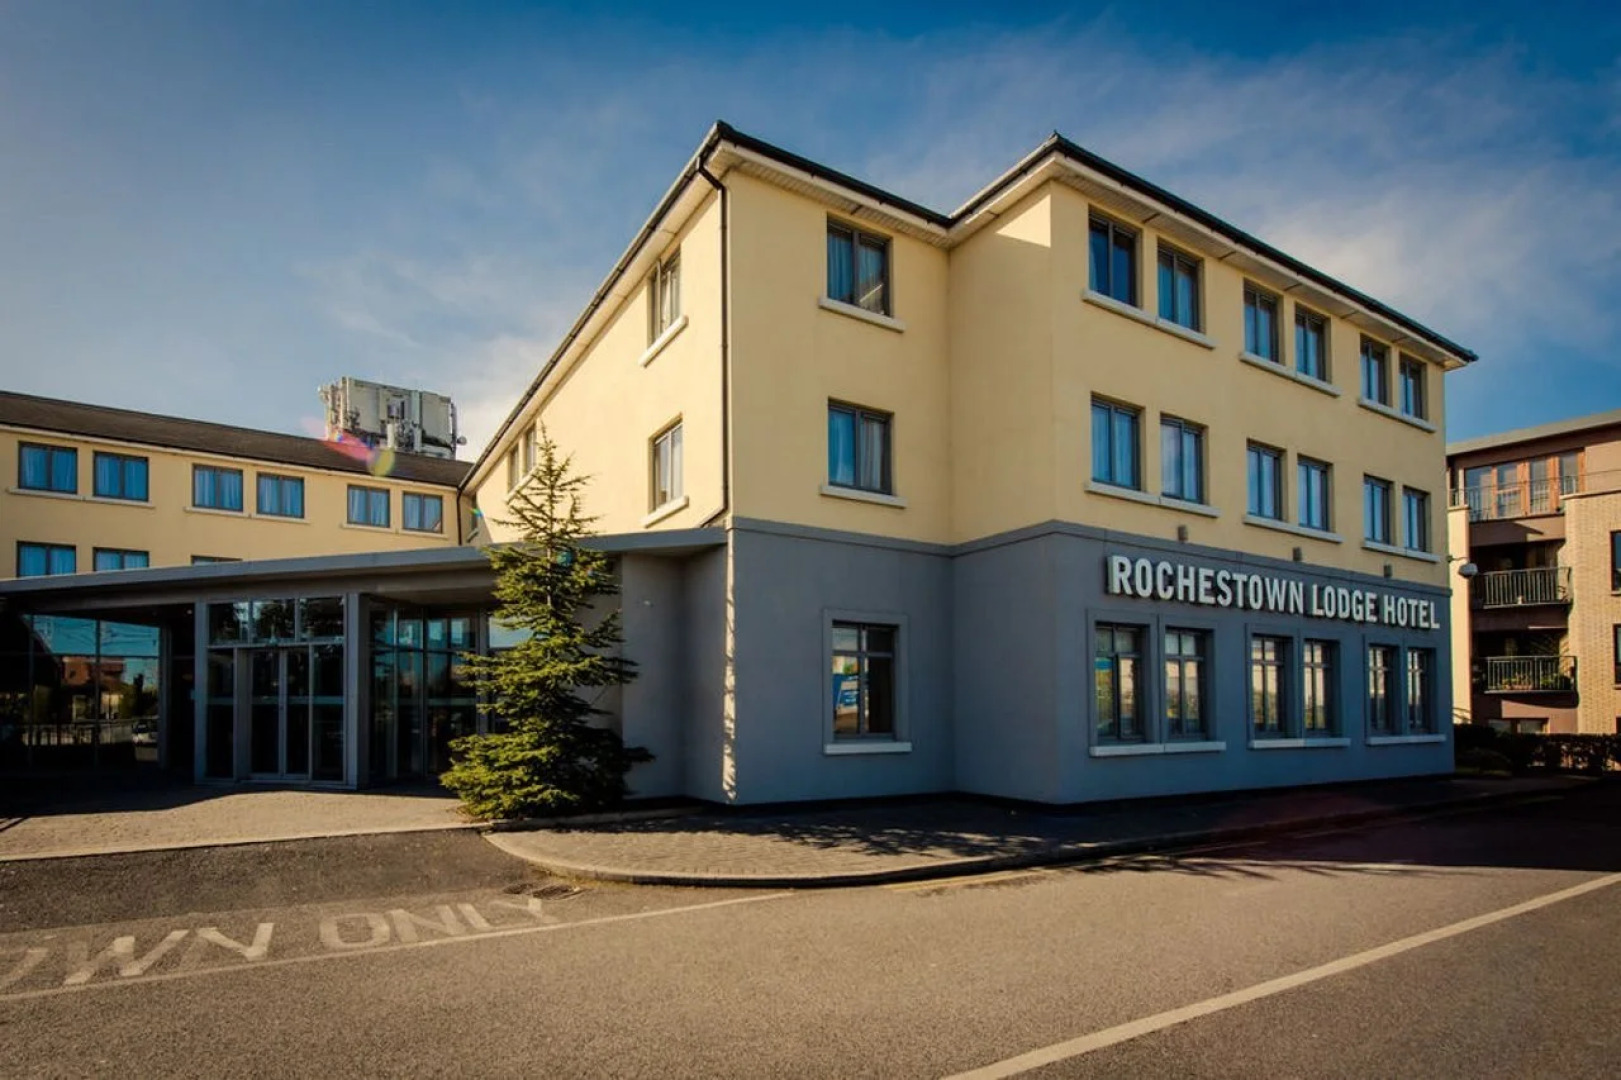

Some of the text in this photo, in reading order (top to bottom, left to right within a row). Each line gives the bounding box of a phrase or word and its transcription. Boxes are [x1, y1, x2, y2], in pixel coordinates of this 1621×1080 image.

[1107, 555, 1440, 630] ROCHESTOWN LODGE HOTEL
[319, 896, 561, 948] ONLY
